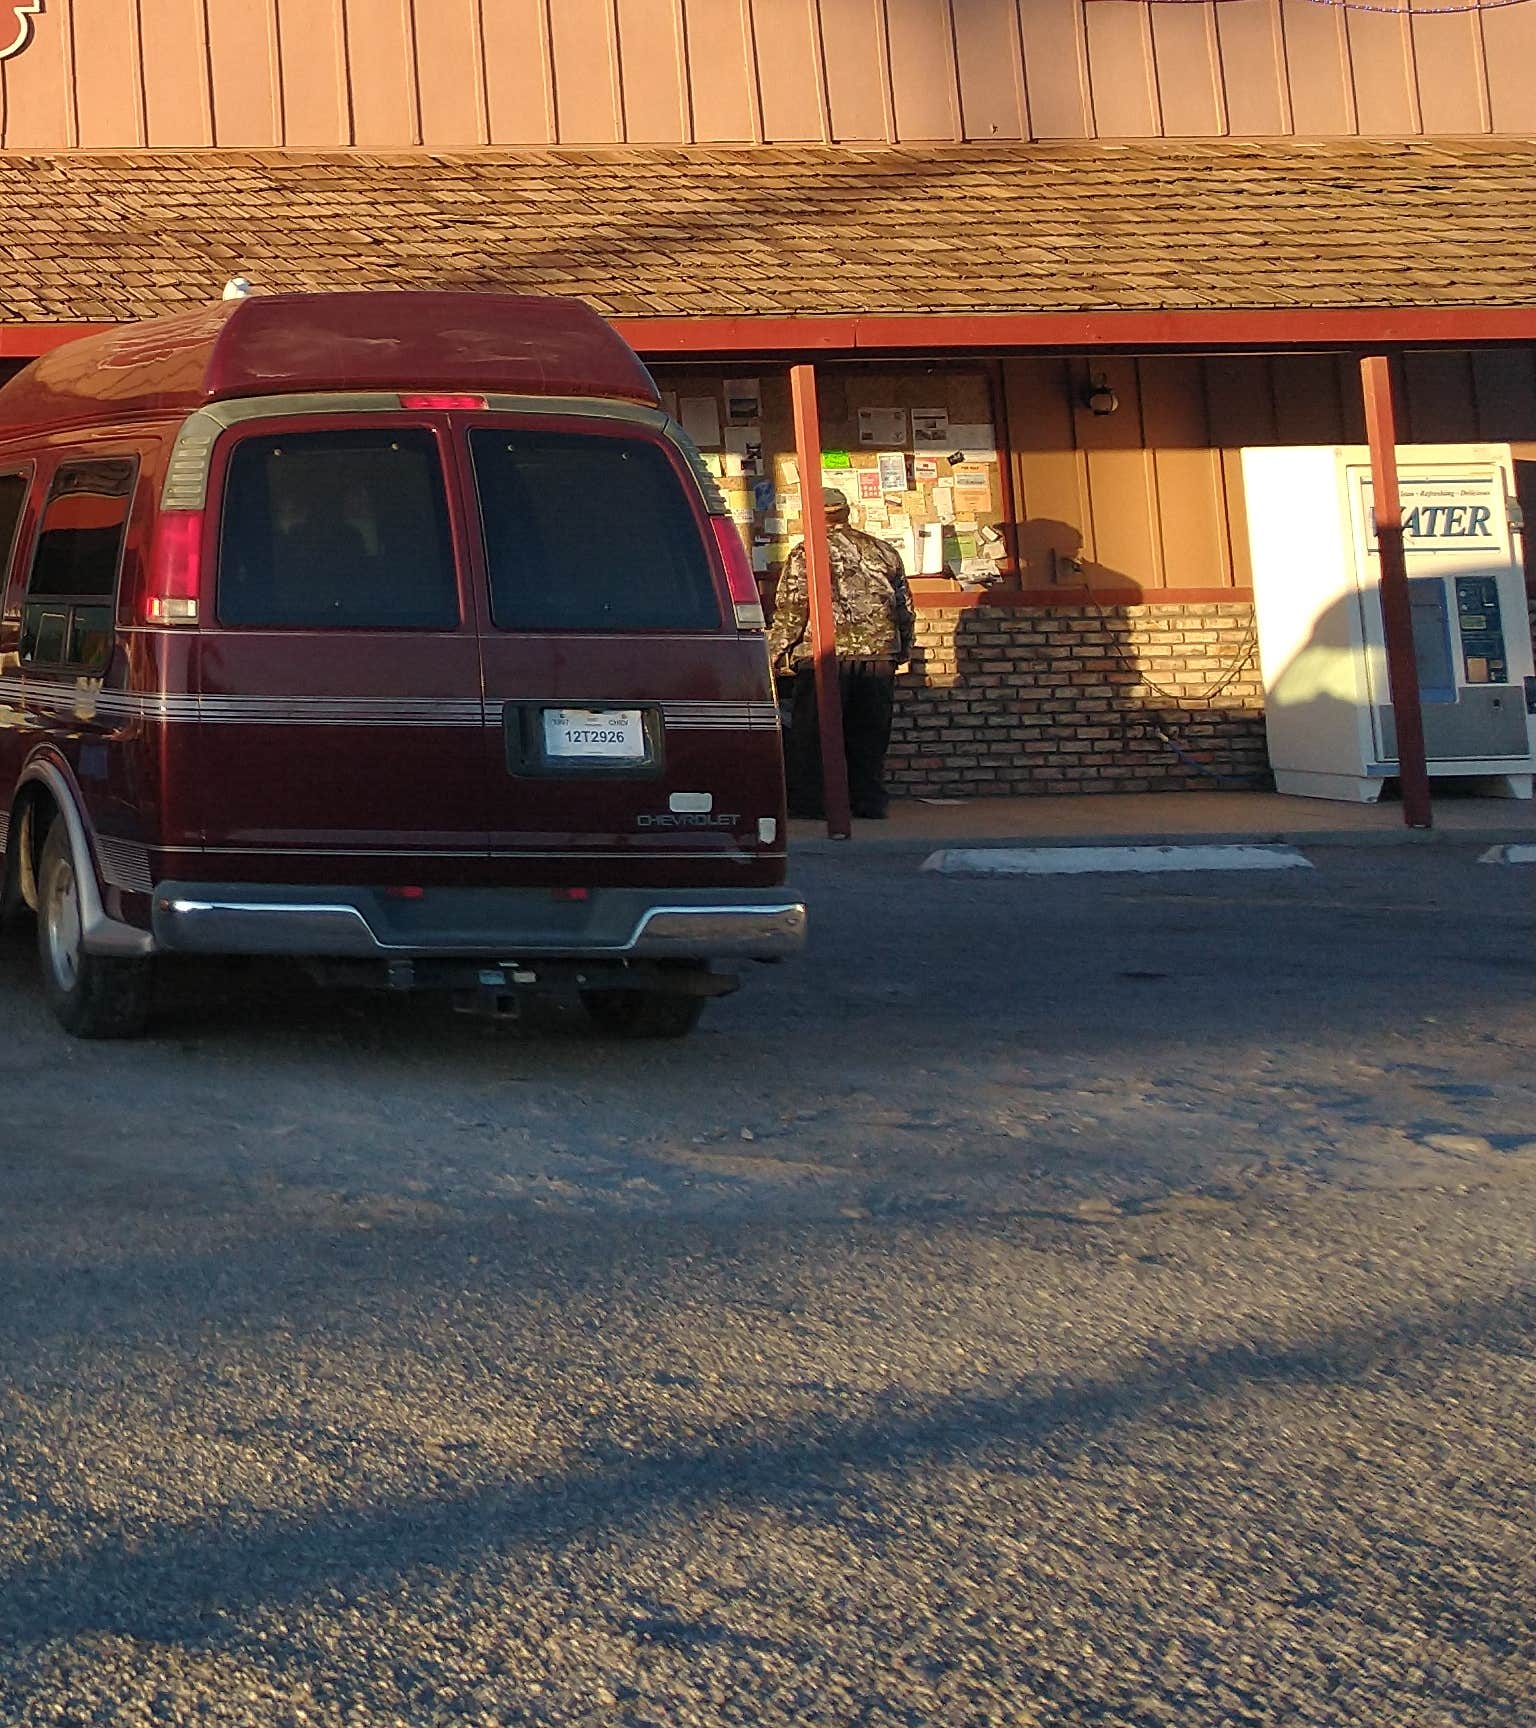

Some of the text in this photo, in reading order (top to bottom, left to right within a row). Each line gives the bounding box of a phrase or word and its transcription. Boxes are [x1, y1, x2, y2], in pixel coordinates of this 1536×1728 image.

[1370, 505, 1493, 538] ATER
[565, 730, 625, 743] 12T2926
[637, 814, 741, 826] CHEVROLET
